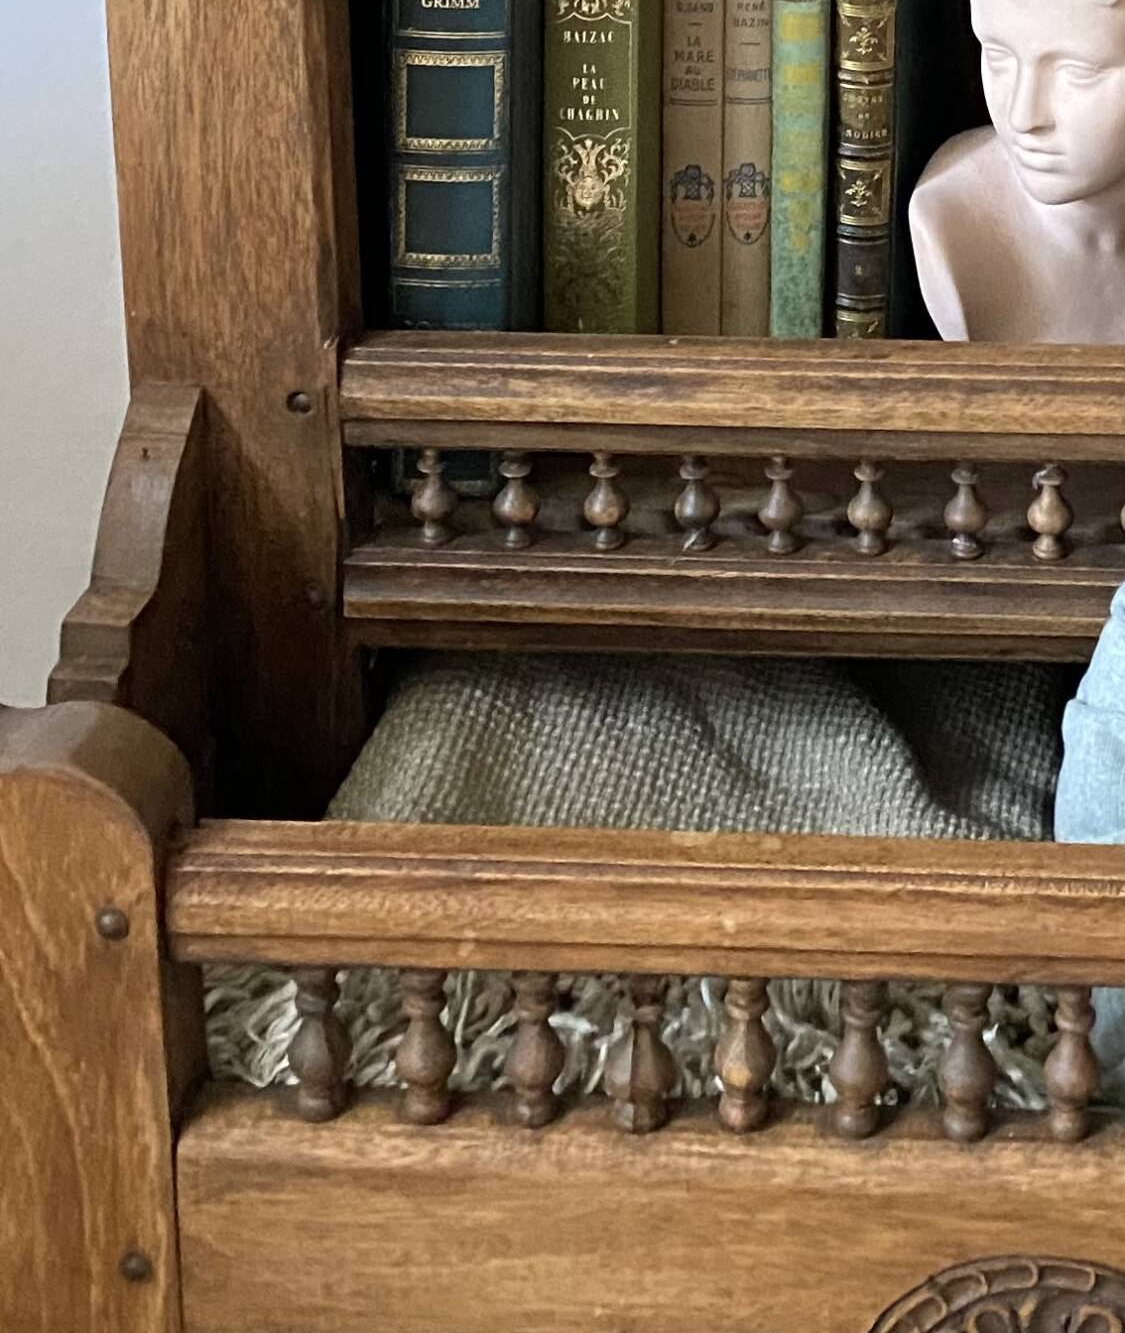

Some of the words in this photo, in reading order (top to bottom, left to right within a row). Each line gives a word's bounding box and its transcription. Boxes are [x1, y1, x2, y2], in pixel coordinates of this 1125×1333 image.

[733, 17, 771, 29] BAZIN
[563, 30, 615, 44] BALZAC
[687, 36, 701, 47] LA
[674, 50, 715, 63] MARE
[582, 63, 597, 74] LA
[684, 65, 702, 76] AU
[670, 77, 716, 92] DIABLE
[582, 94, 597, 105] DE
[558, 107, 620, 121] CHAGRIN
